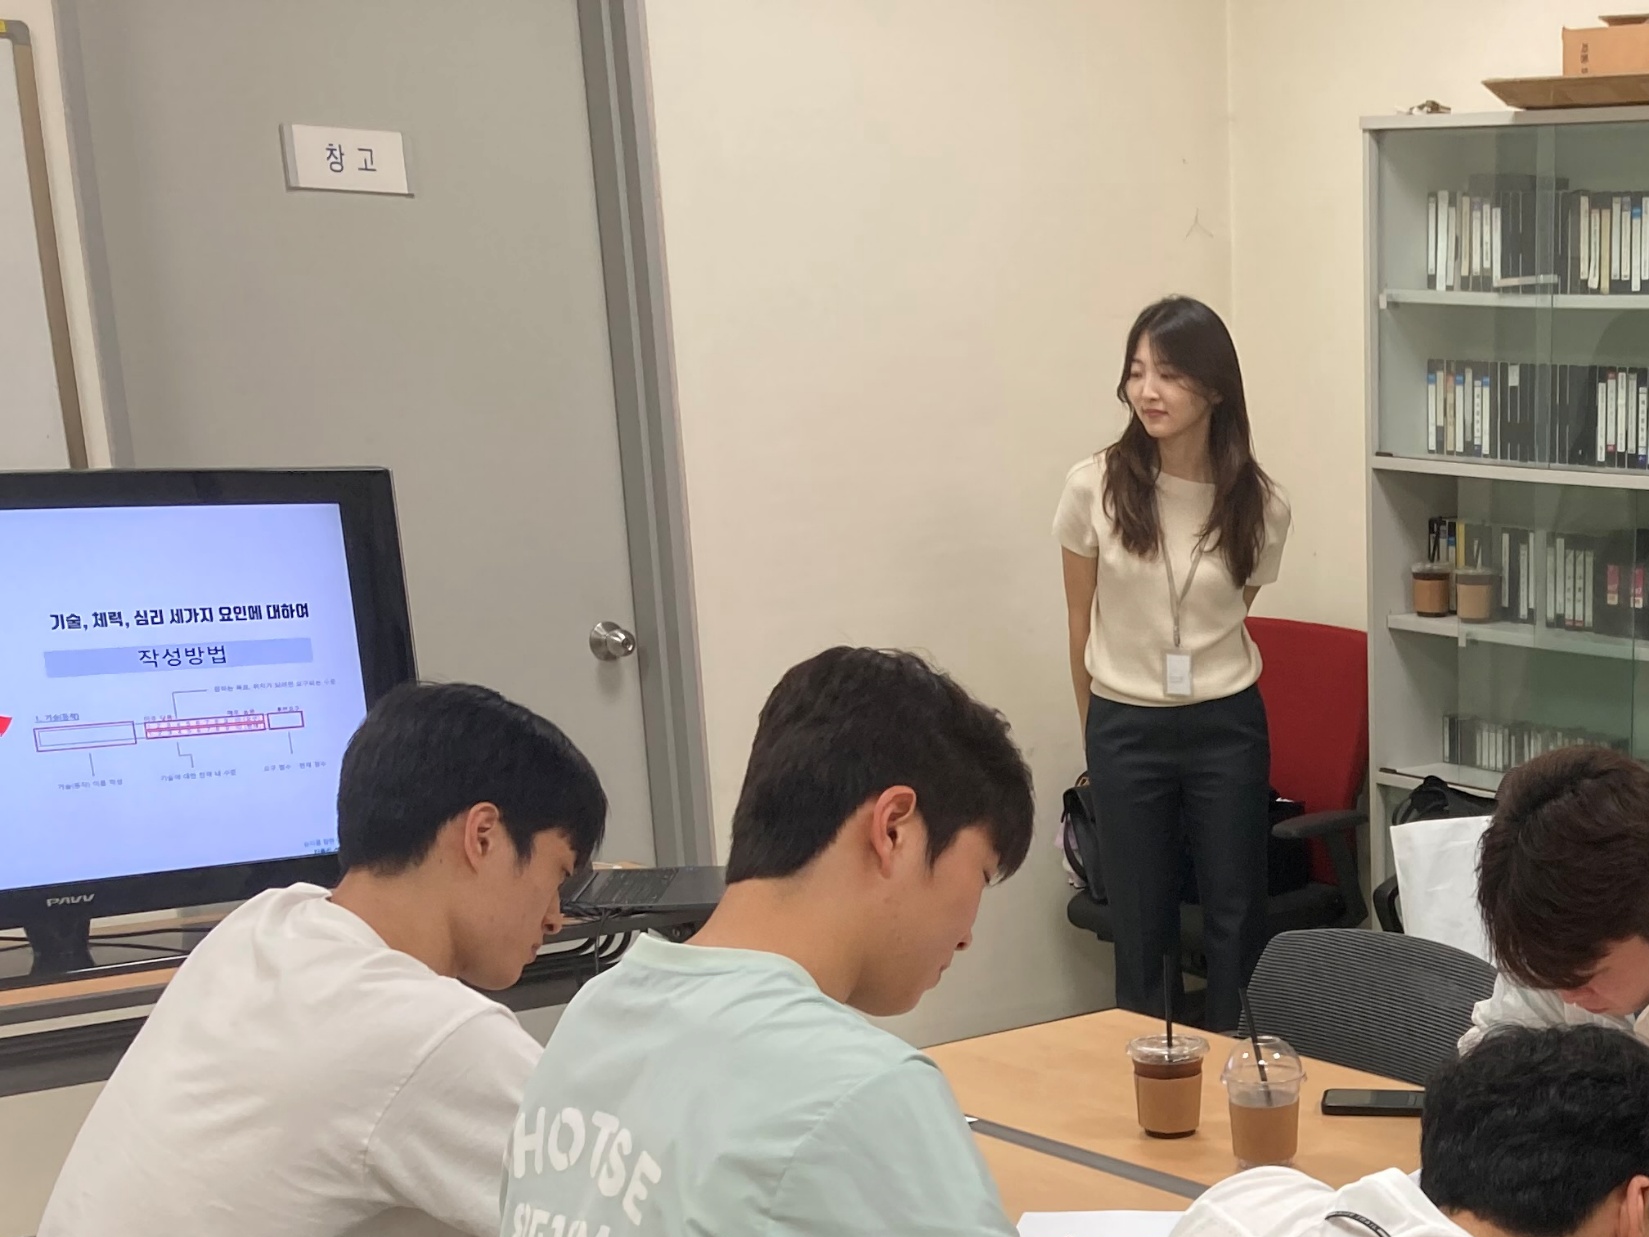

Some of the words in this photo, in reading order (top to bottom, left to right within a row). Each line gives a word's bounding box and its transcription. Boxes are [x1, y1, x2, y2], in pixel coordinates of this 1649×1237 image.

[50, 613, 88, 631] 기술,
[92, 611, 130, 629] 체력,
[134, 609, 164, 626] 심리
[169, 607, 214, 624] 세가지
[218, 605, 263, 623] 요인에
[267, 603, 309, 620] 대하여
[138, 645, 227, 668] 작성방법
